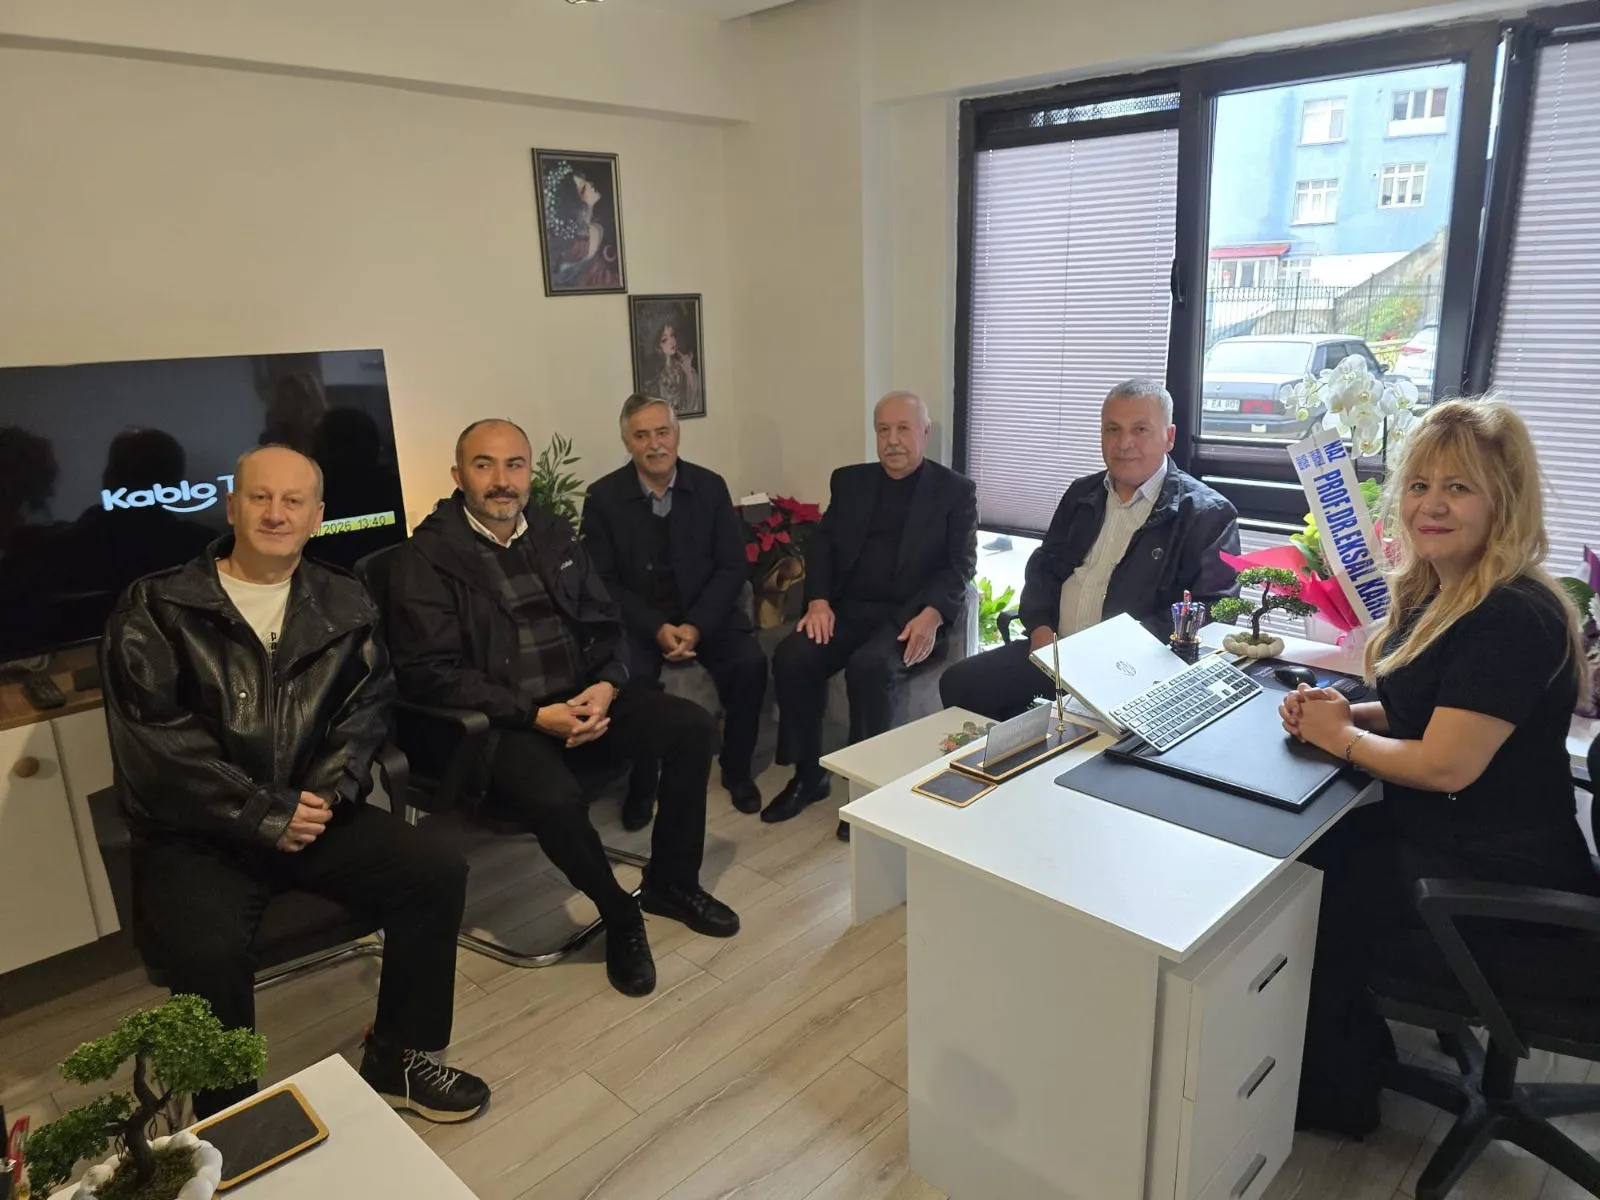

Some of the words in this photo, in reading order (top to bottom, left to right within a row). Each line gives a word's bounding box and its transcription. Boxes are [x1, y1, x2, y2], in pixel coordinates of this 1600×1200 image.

[1322, 439, 1347, 463] NAZ
[101, 480, 217, 511] Kablo
[358, 515, 387, 531] 13:40
